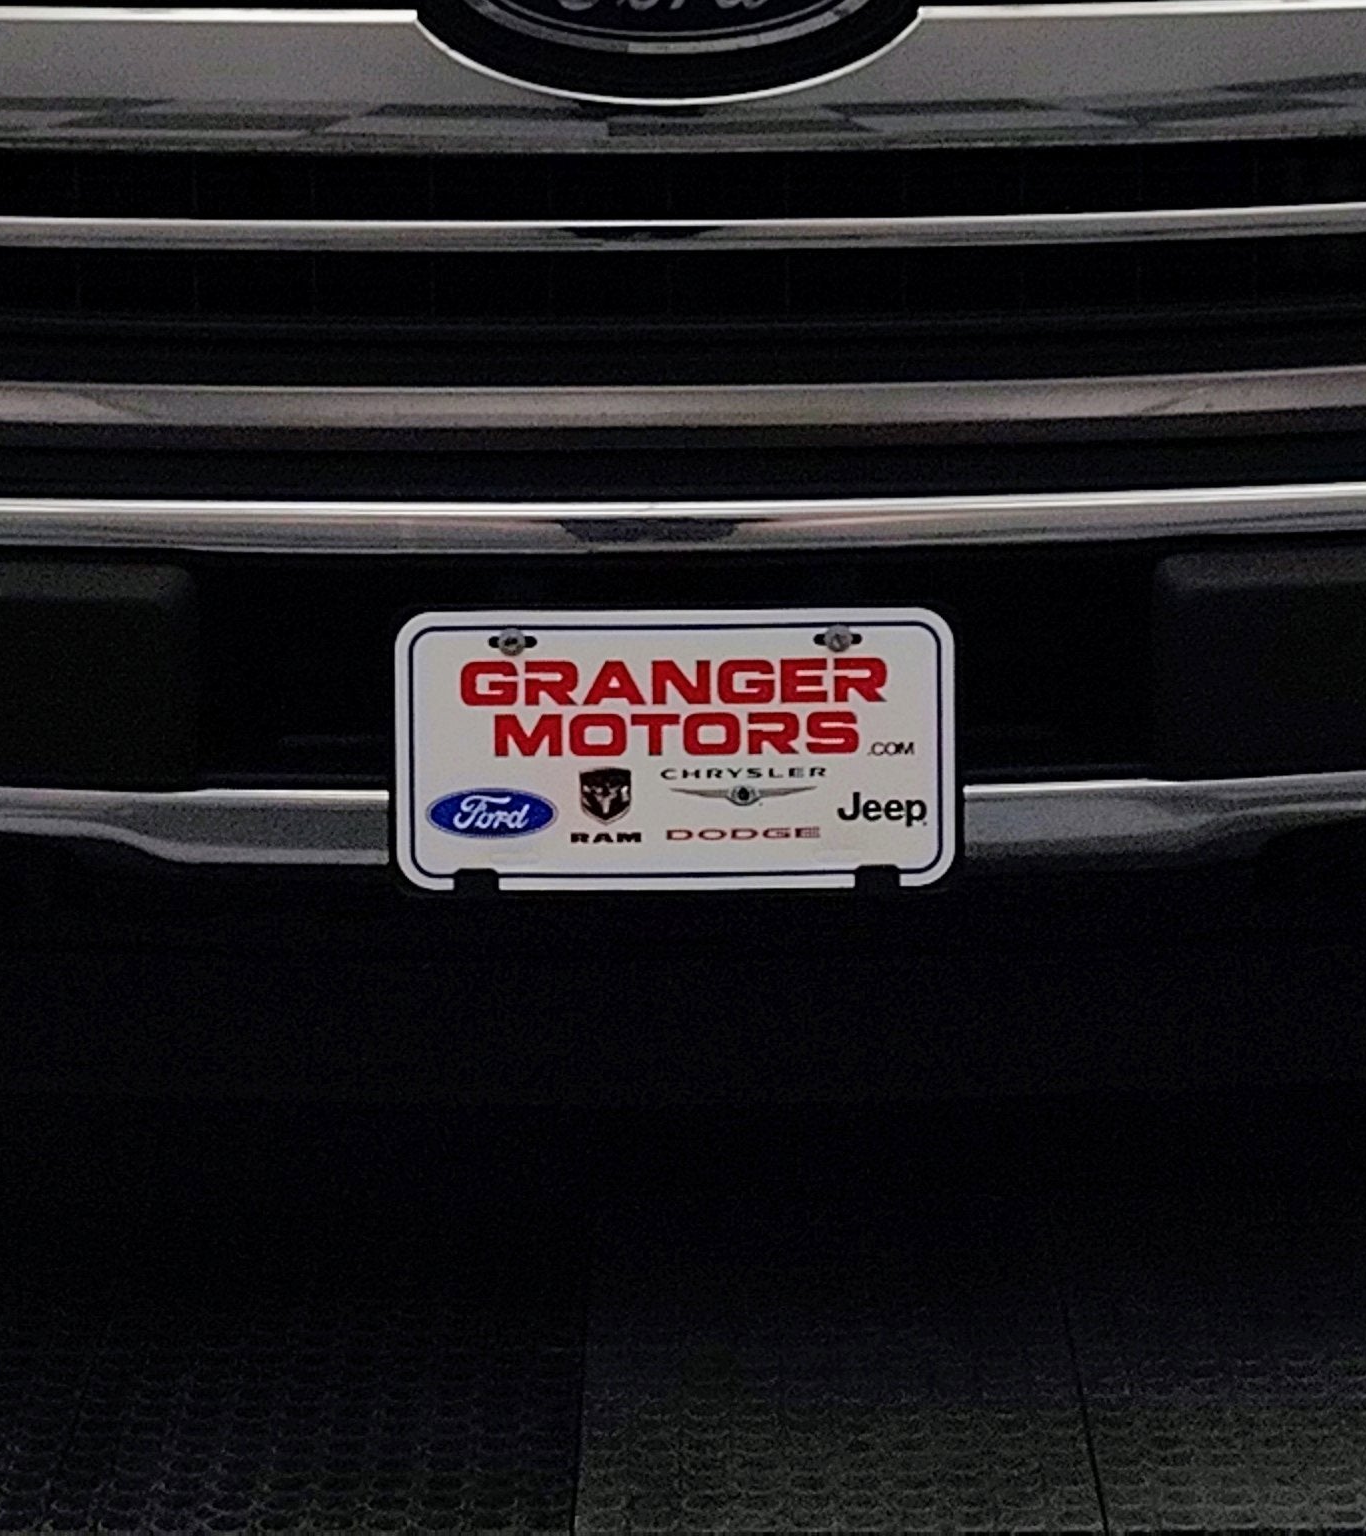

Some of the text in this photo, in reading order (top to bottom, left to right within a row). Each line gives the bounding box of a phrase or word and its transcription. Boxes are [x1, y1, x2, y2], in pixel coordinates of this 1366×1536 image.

[459, 657, 888, 706] GRANGER
[493, 710, 860, 758] MOTORS
[660, 766, 827, 780] CHRYSLER
[452, 794, 530, 832] Ford
[837, 791, 927, 827] Jeep
[570, 831, 643, 844] RAM
[665, 826, 821, 841] DODGE
